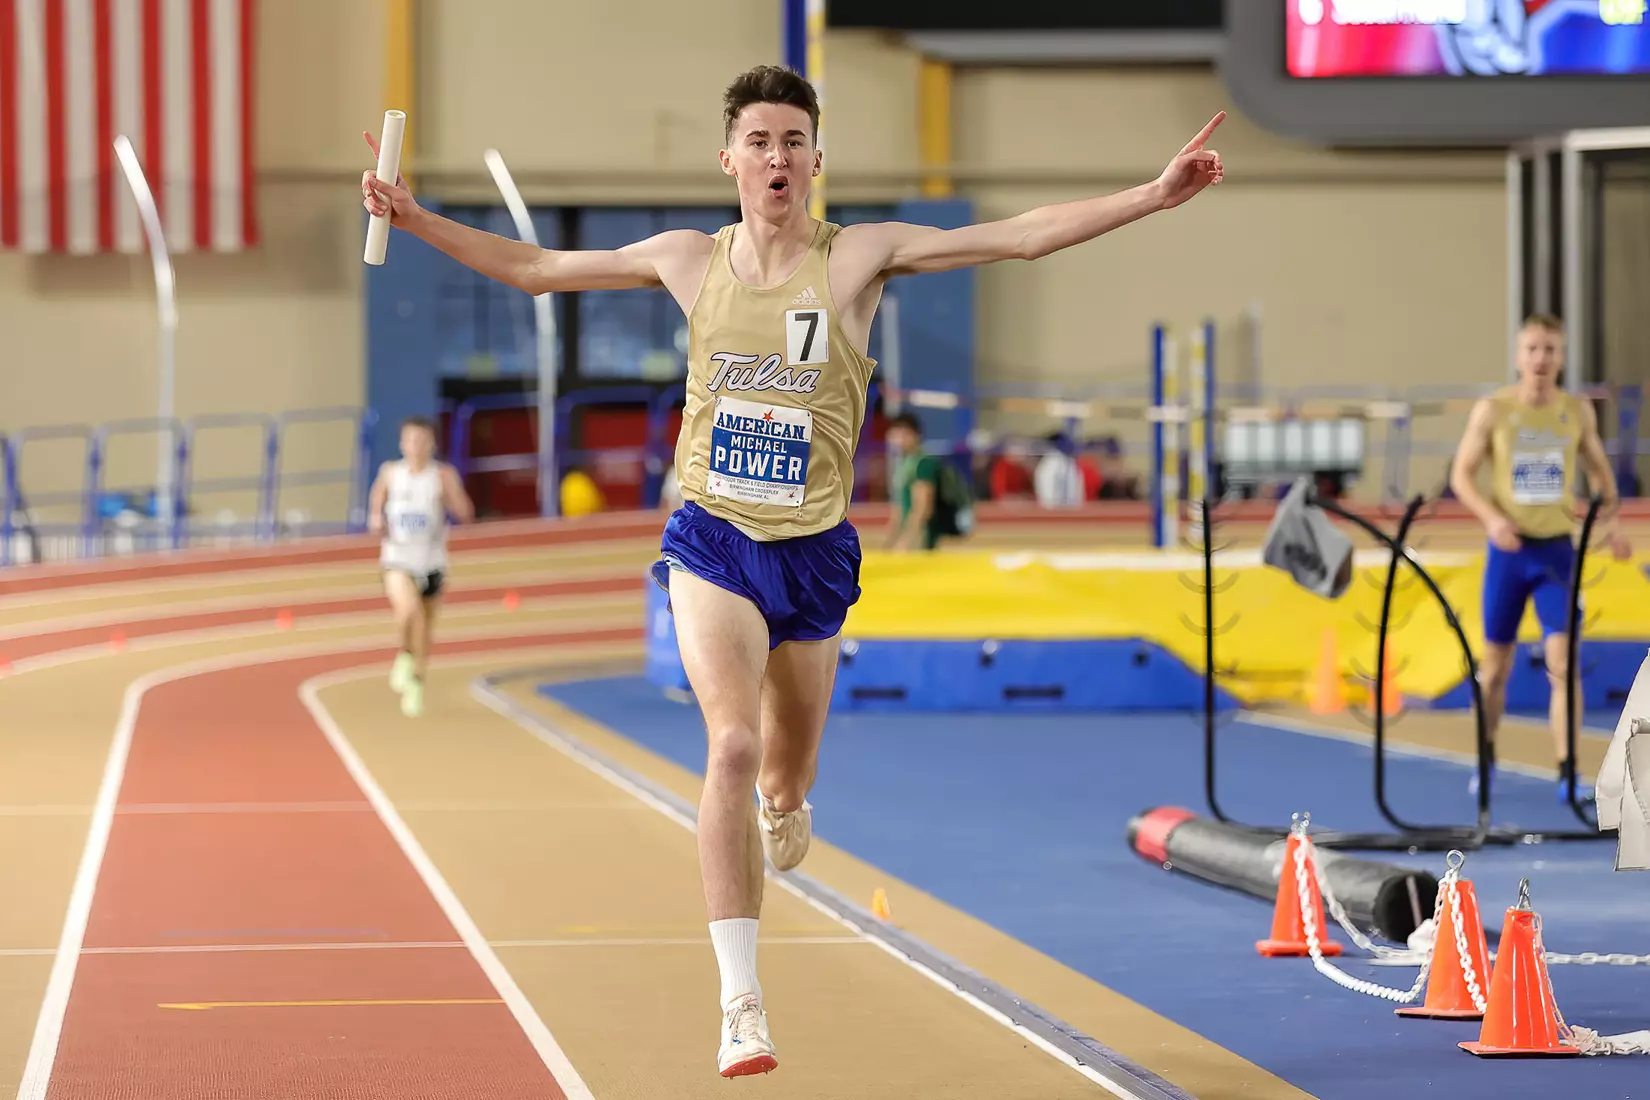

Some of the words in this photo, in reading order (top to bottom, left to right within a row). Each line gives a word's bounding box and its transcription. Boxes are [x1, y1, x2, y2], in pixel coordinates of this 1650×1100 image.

[794, 312, 819, 361] 7
[706, 352, 822, 393] Tulsa
[716, 411, 806, 440] AMERICAN
[731, 434, 788, 454] MICHAEL
[714, 445, 803, 481] POWER
